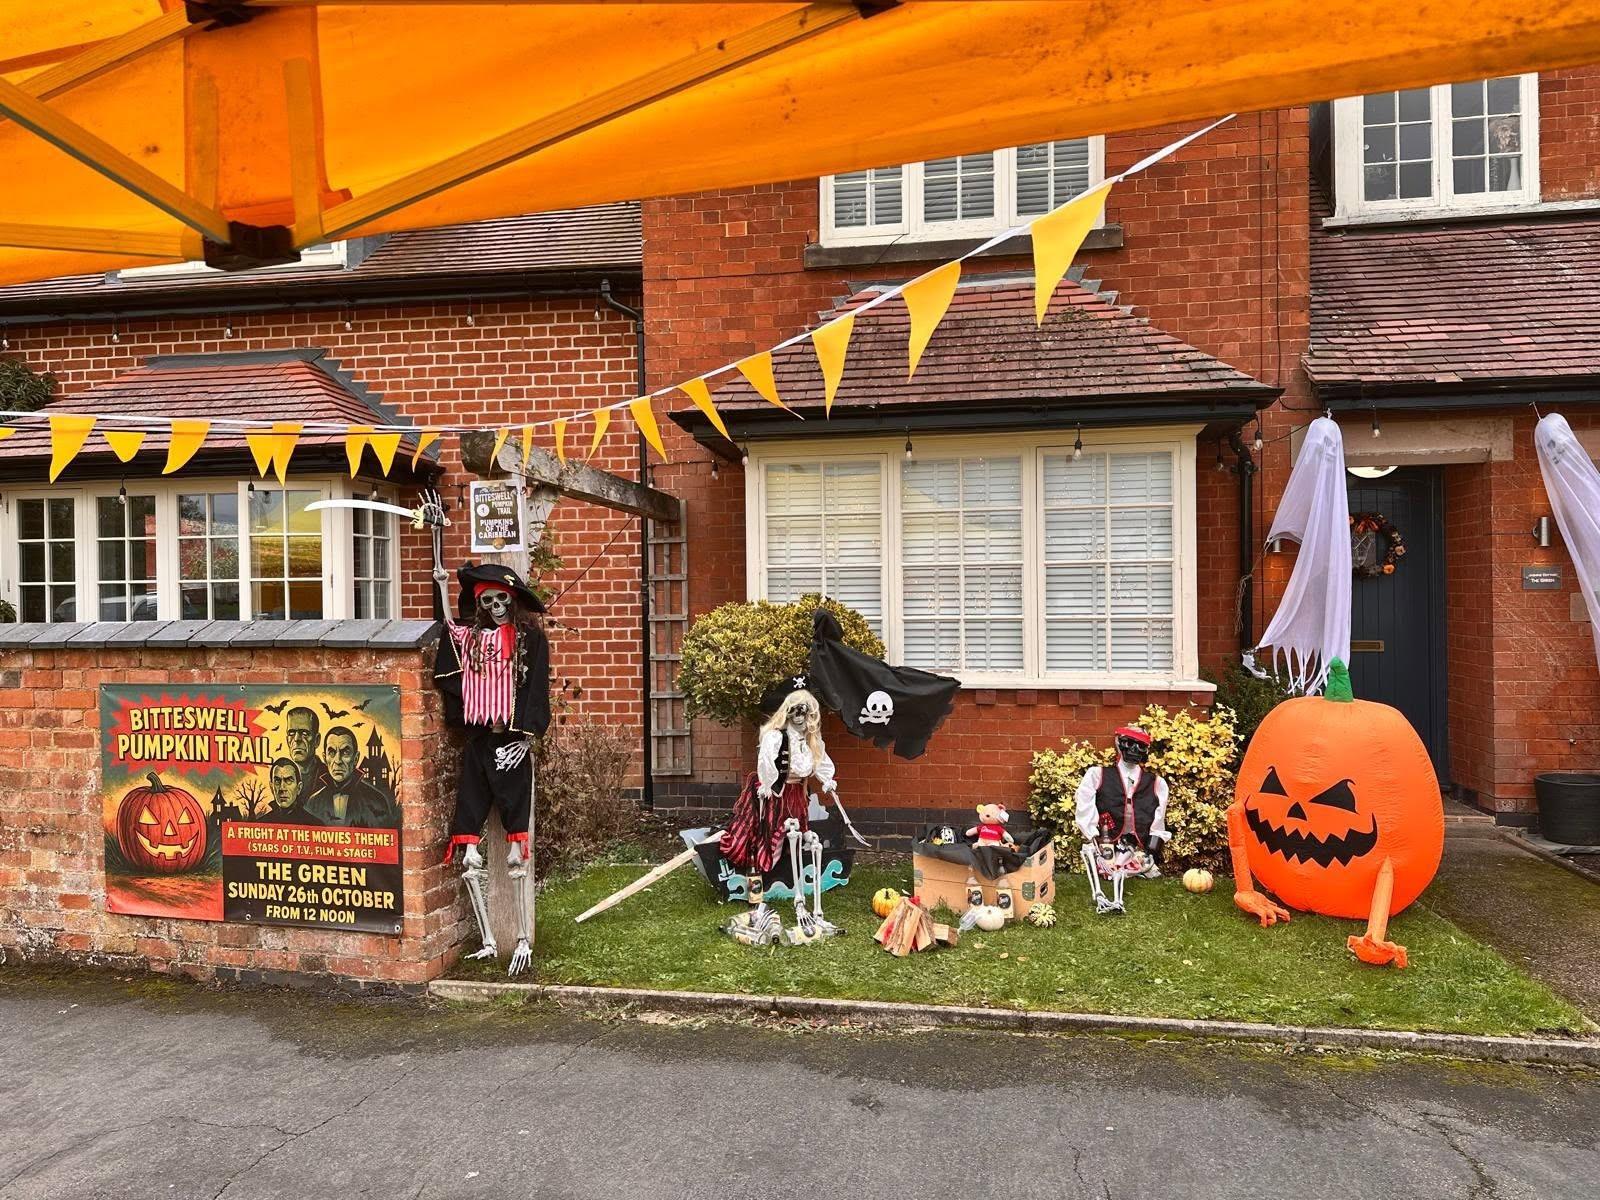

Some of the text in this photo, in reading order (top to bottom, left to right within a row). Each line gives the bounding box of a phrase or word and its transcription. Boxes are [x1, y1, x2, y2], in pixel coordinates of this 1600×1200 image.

[474, 491, 511, 503] BITTESWELL
[497, 507, 512, 515] TRAIL
[478, 531, 516, 539] CARIBBEAN
[129, 706, 249, 733] BITTESWELL
[117, 734, 273, 764] PUMPKIN TRAIL
[227, 827, 394, 847] A FRIGHT AT THE MOVIES THEME!
[248, 842, 279, 853] (STARS
[281, 844, 294, 853] OF
[315, 846, 335, 857] FILM
[336, 849, 342, 857] &
[343, 847, 377, 860] STAGE)
[255, 861, 367, 887] THE GREEN
[228, 881, 395, 910] SUNDAY 26th OCTOBER
[265, 904, 355, 924] FROM 12 NOON
